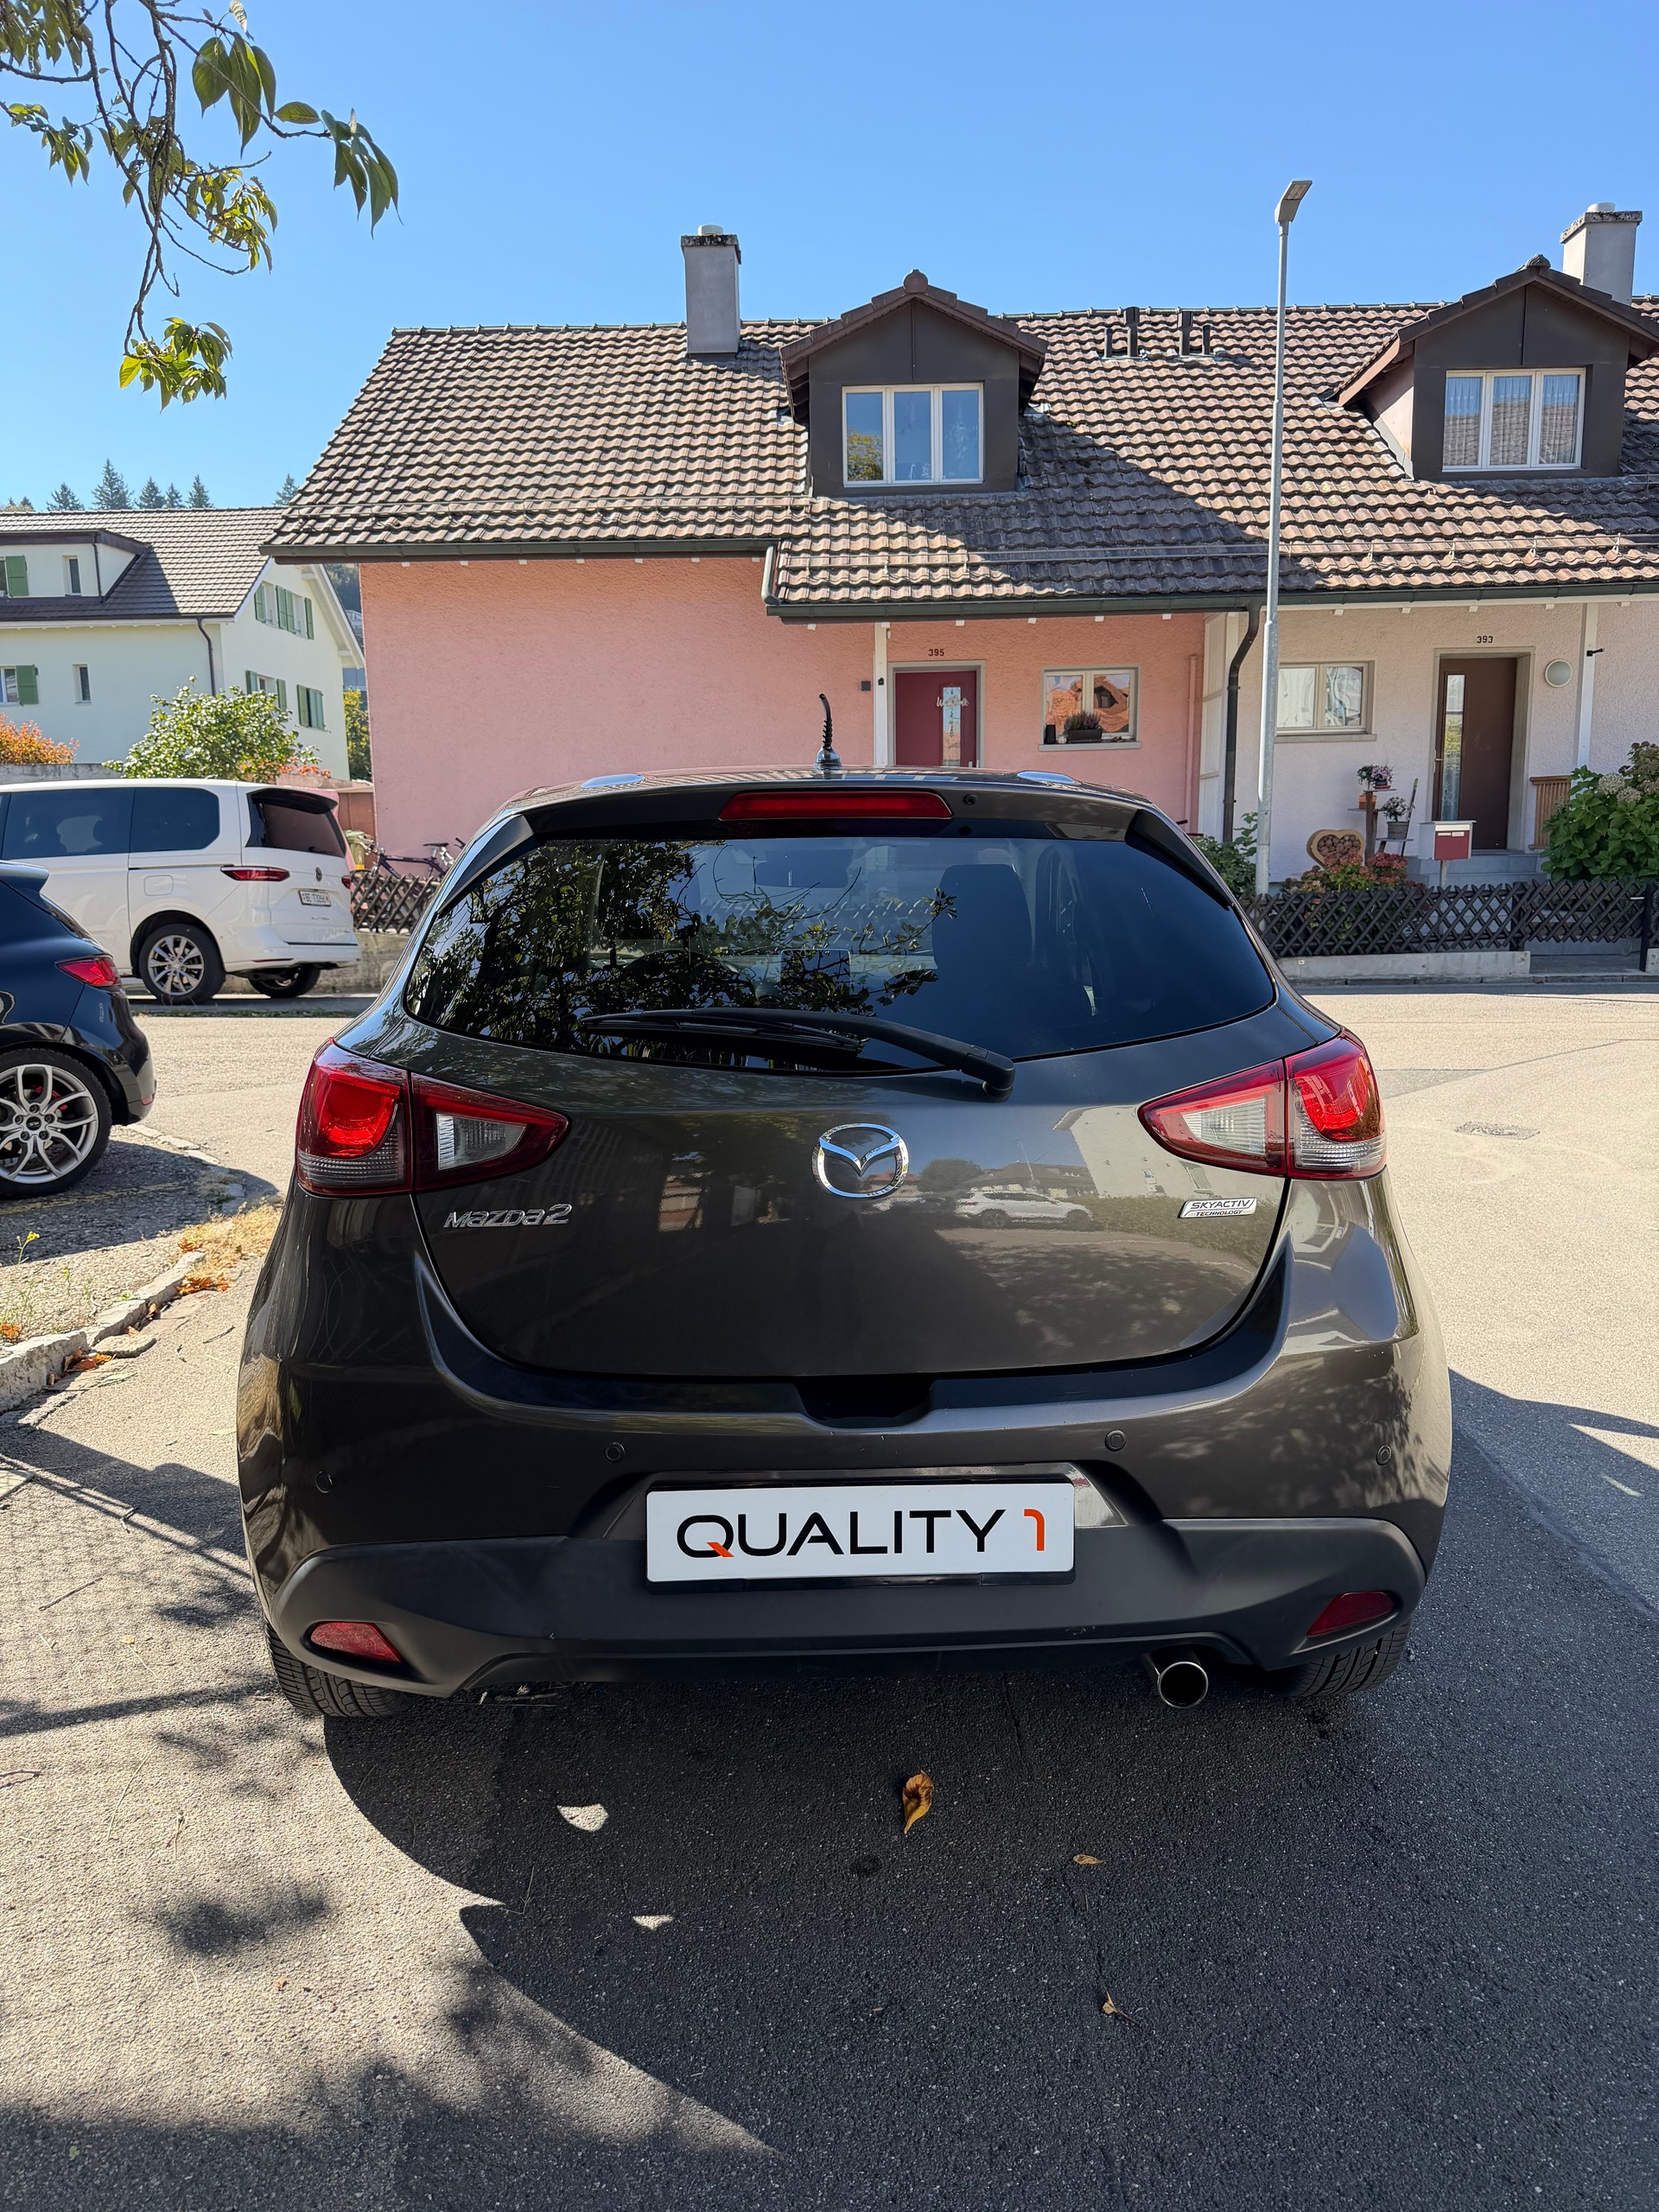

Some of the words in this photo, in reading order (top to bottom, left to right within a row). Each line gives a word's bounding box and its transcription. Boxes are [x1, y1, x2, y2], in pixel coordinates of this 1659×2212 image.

[1477, 635, 1493, 644] 393
[928, 648, 944, 657] 395
[1190, 1199, 1250, 1210] SKYACTIV
[677, 1509, 1007, 1559] QUALITY
[1023, 1508, 1046, 1552] 1
